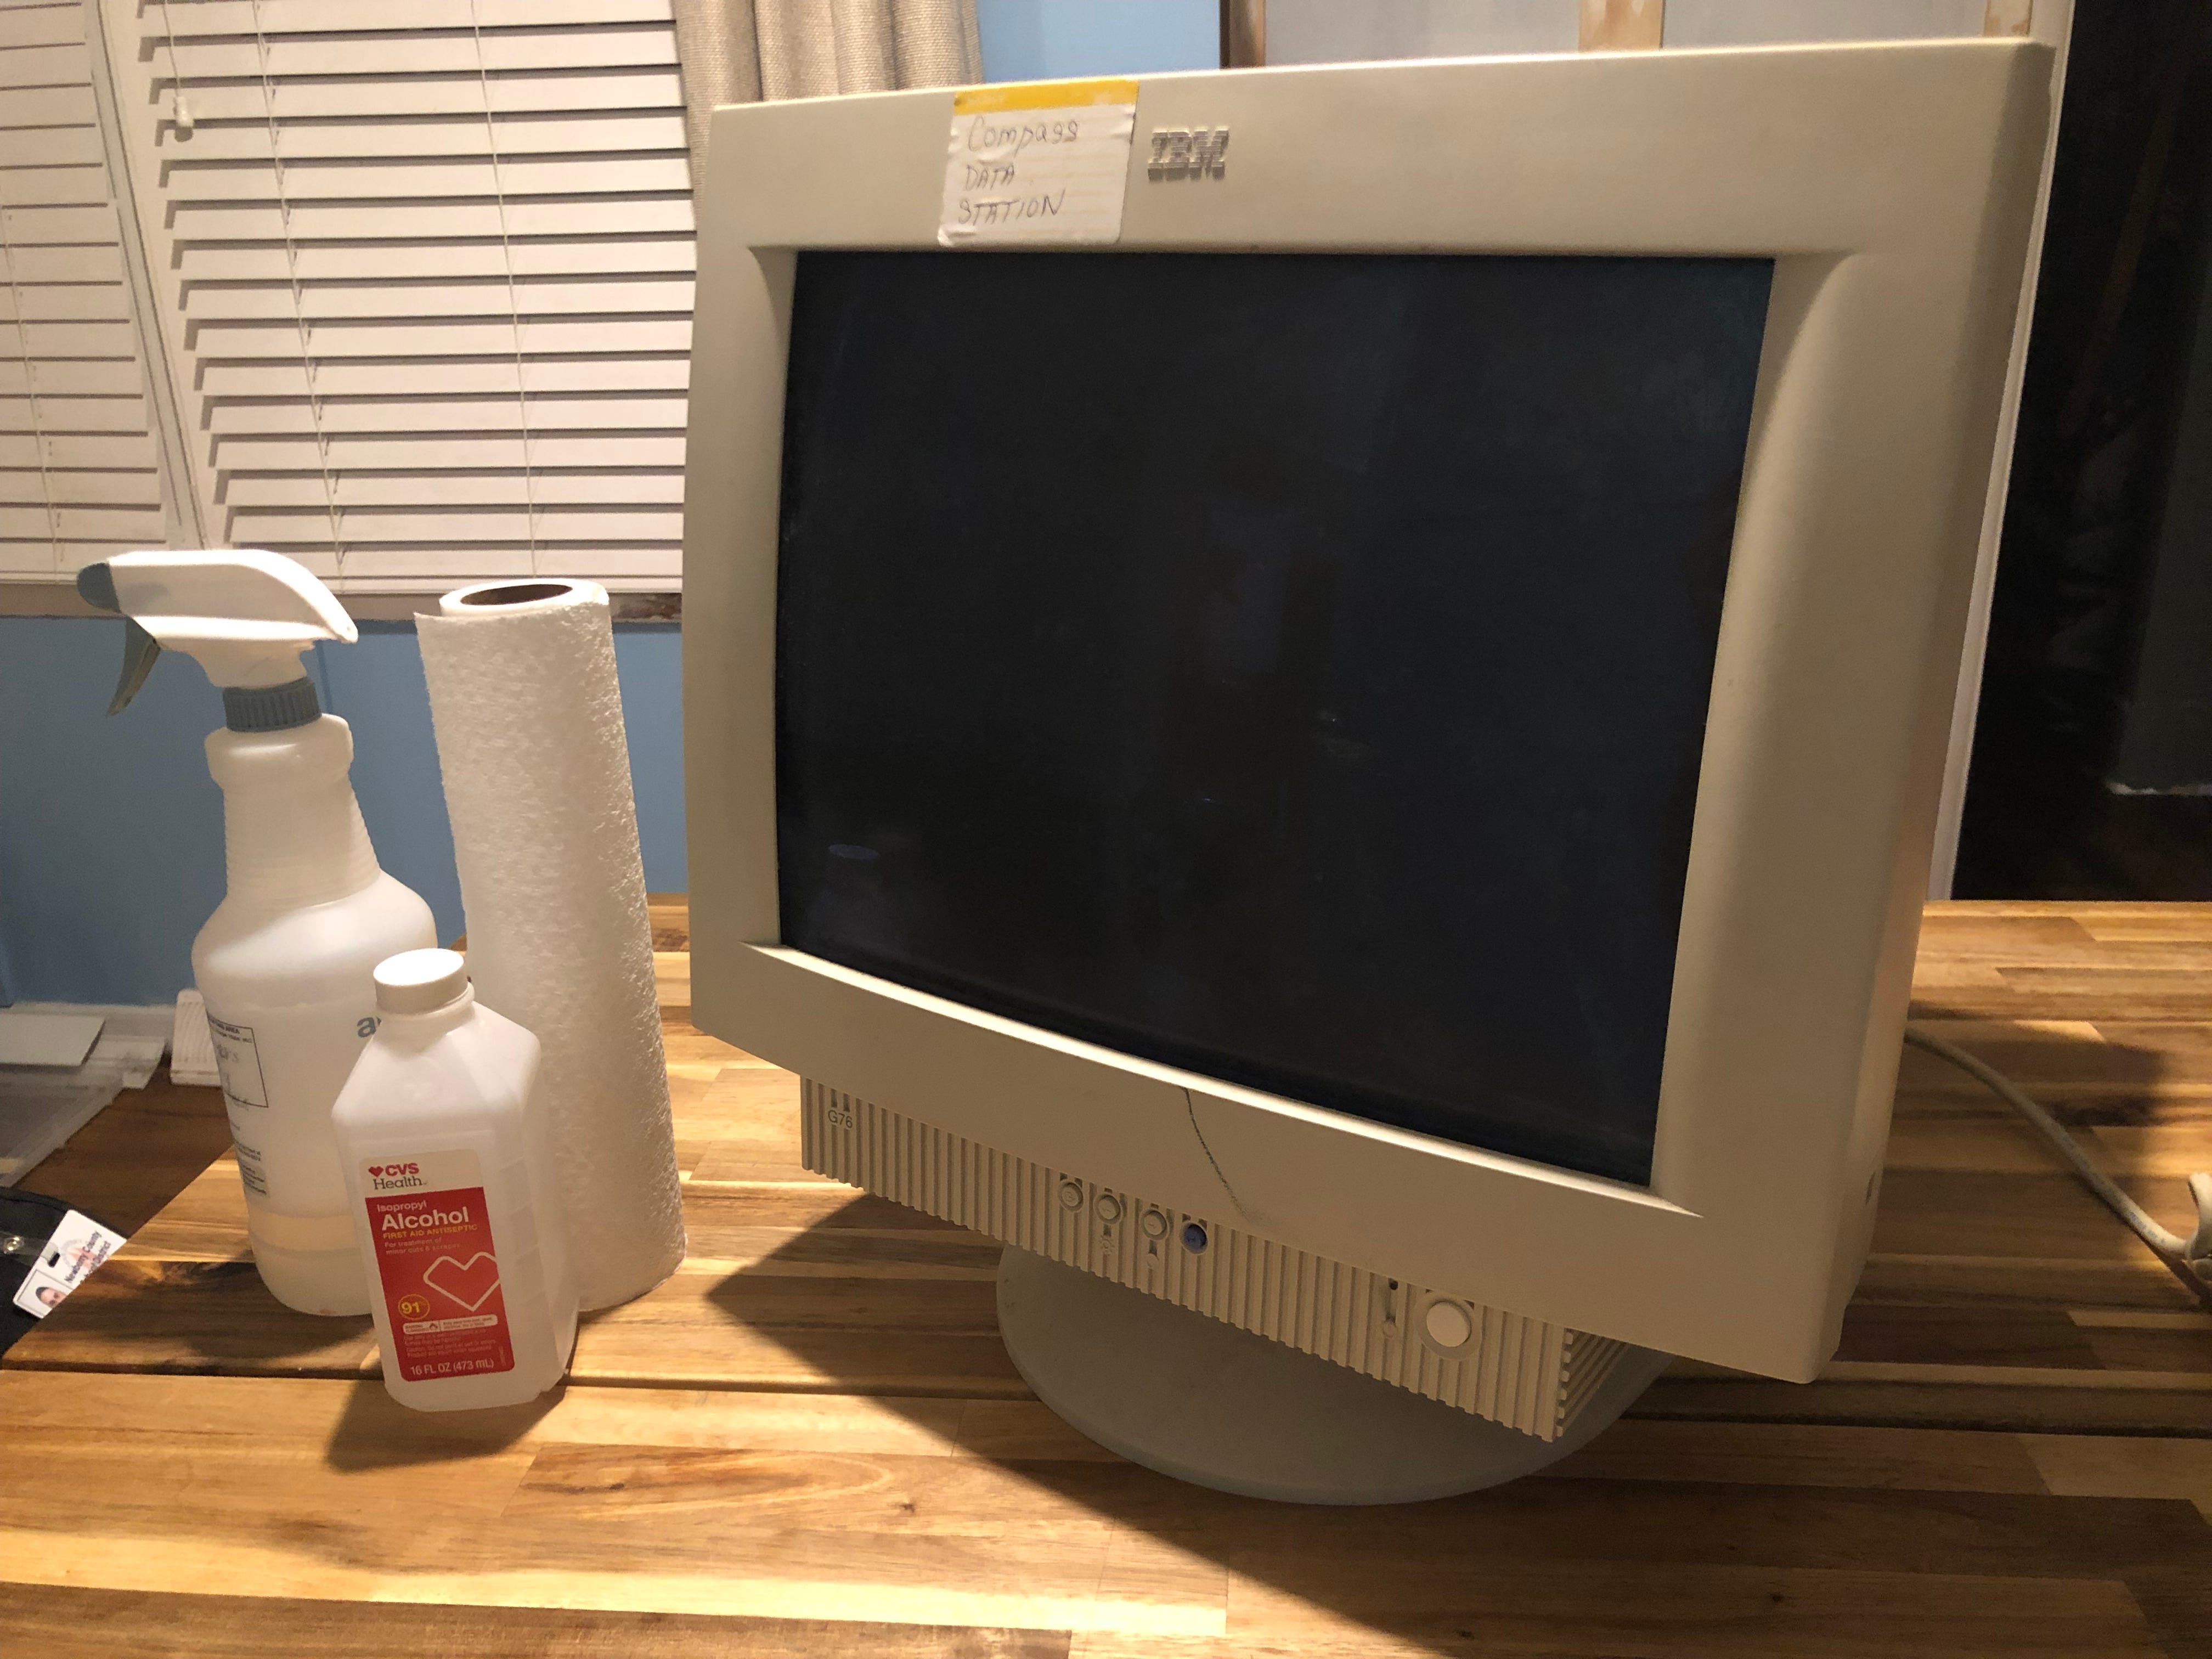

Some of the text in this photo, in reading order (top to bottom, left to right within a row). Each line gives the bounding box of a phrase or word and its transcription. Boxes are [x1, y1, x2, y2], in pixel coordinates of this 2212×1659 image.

[1148, 127, 1229, 176] IBM
[966, 164, 1015, 191] DATA
[958, 188, 1066, 226] STATION
[827, 1109, 853, 1129] G76
[385, 1162, 420, 1177] CVS
[373, 1176, 424, 1190] Health
[377, 1199, 427, 1212] Isopropyl
[382, 1206, 469, 1231] Alcohol
[82, 1231, 101, 1252] County
[383, 1231, 407, 1239] FIRST
[427, 1224, 477, 1235] ANTISEPTIC
[93, 1241, 111, 1264] District
[401, 1302, 421, 1314] 91
[410, 1358, 494, 1375] 16 FL OZ (473 mL)
